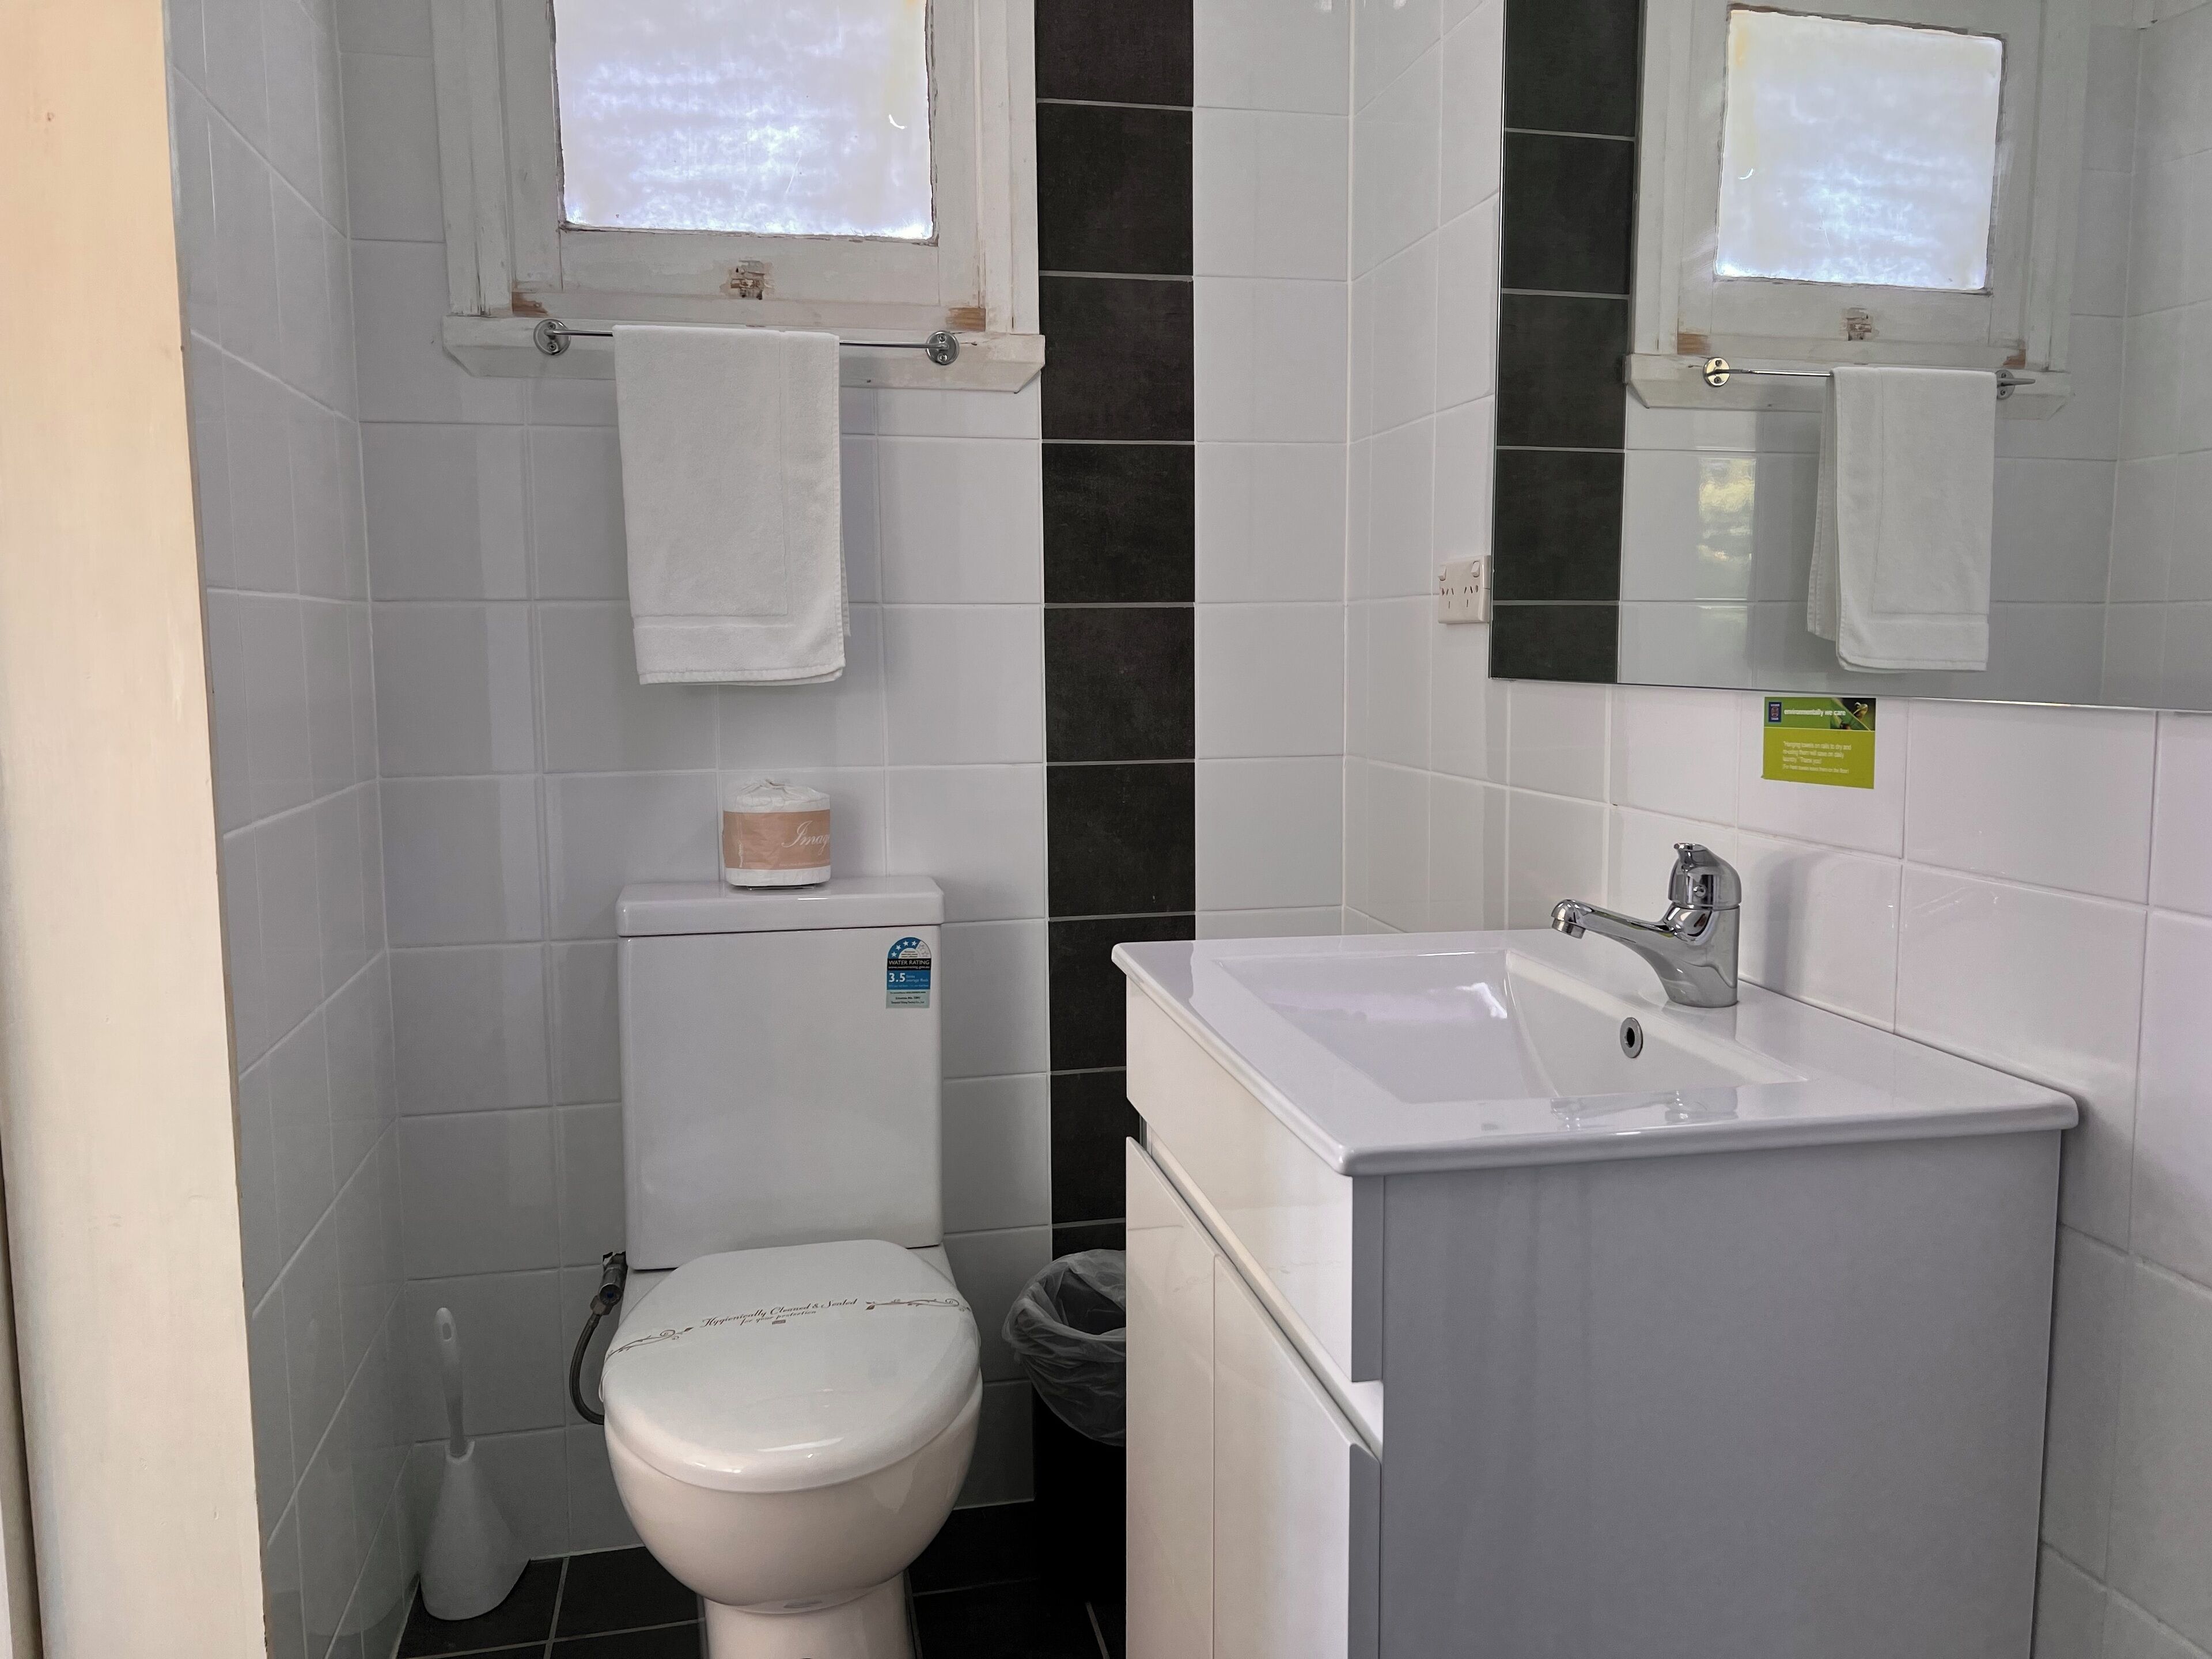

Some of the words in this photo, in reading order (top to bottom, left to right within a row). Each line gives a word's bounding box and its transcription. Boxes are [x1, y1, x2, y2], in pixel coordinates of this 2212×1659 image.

[889, 972, 906, 983] 3.5
[700, 1309, 767, 1328] Hygienically
[770, 1302, 812, 1316] Cleaned
[821, 1298, 858, 1309] Sealed
[776, 1310, 816, 1320] protection
